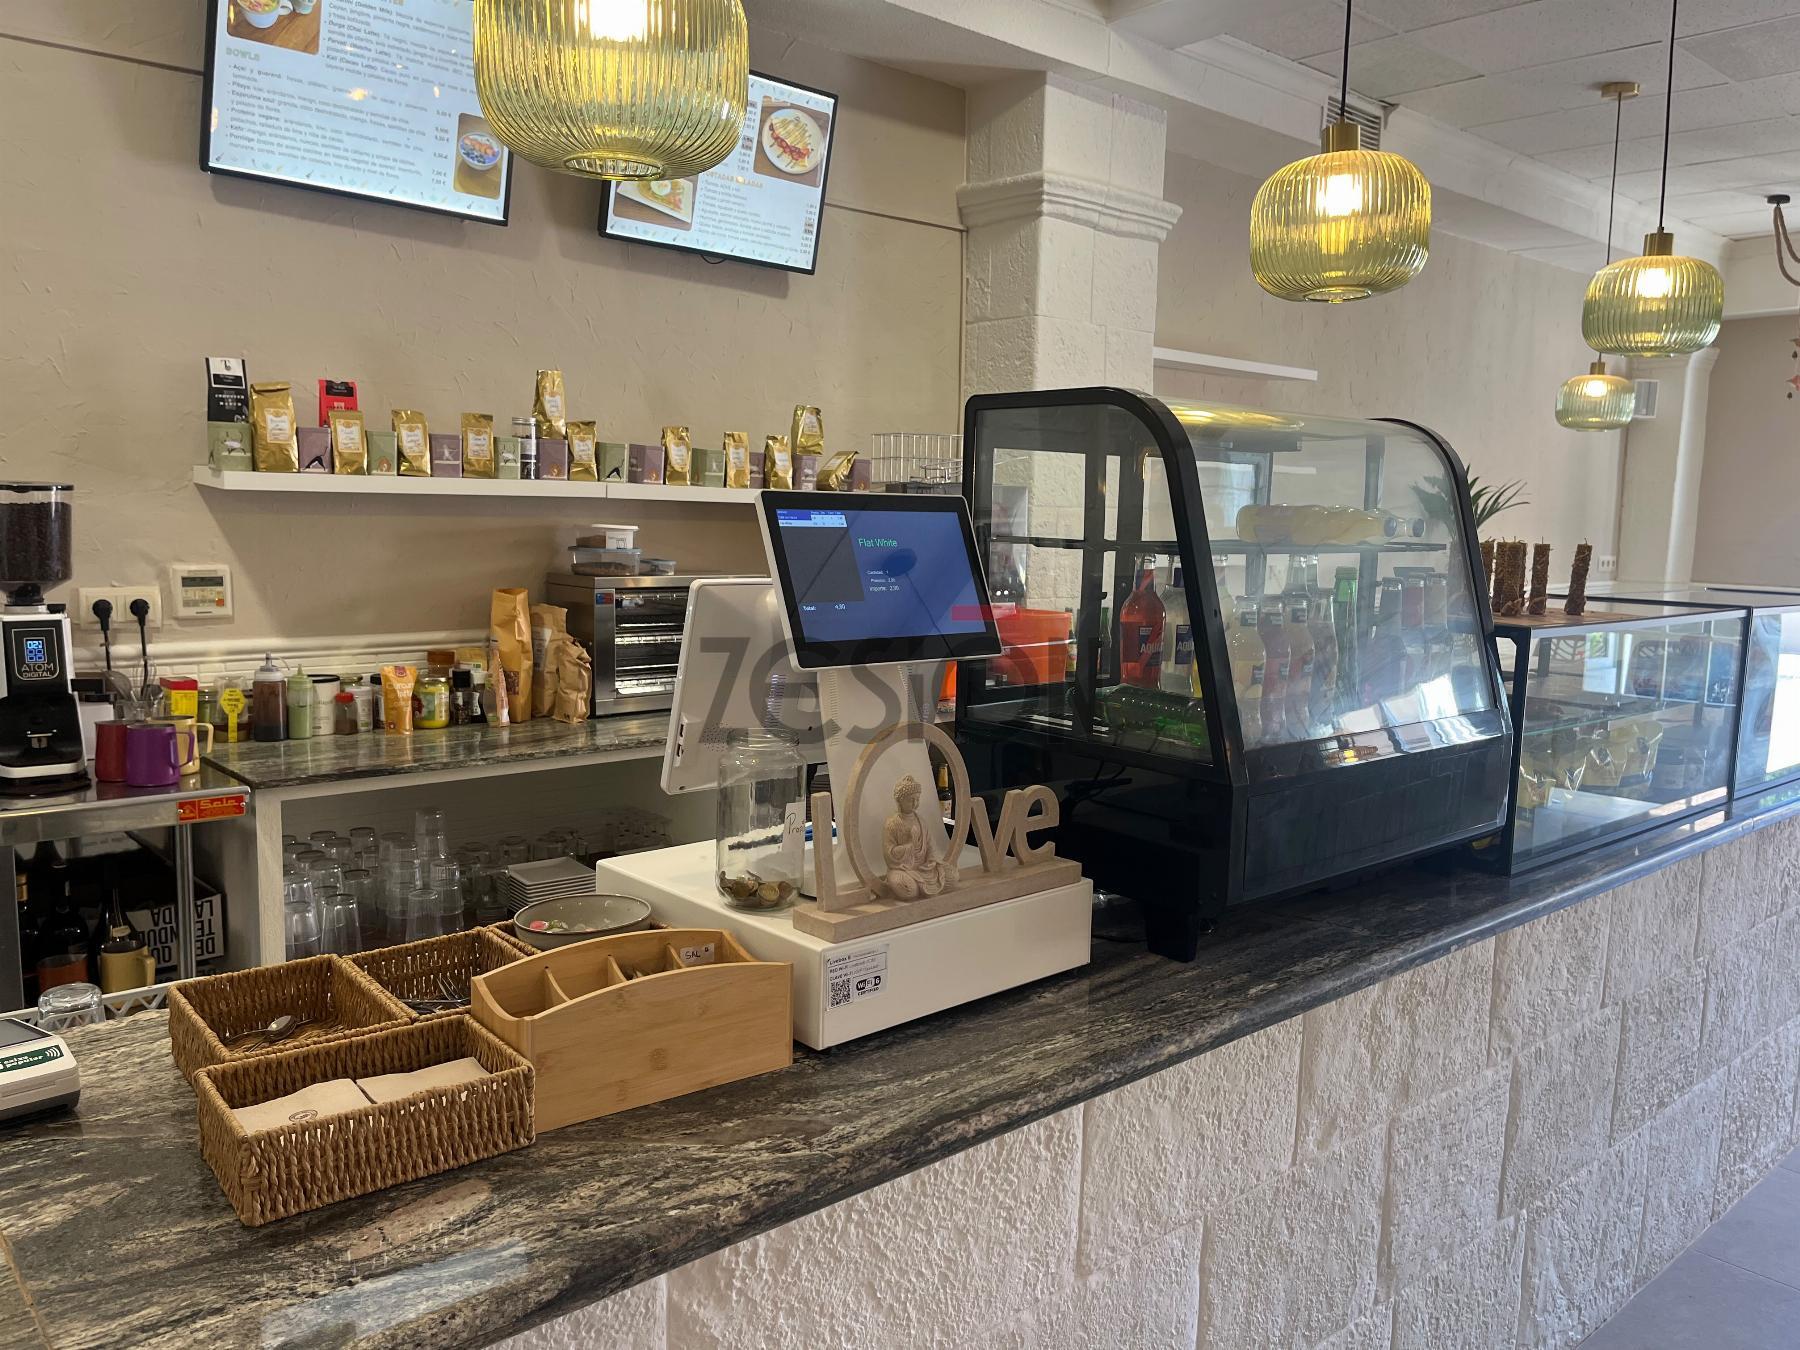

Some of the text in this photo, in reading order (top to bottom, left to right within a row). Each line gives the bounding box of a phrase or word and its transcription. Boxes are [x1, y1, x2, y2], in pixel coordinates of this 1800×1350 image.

[858, 538, 875, 547] Flat
[21, 662, 54, 673] ATOM
[684, 950, 701, 960] SAL
